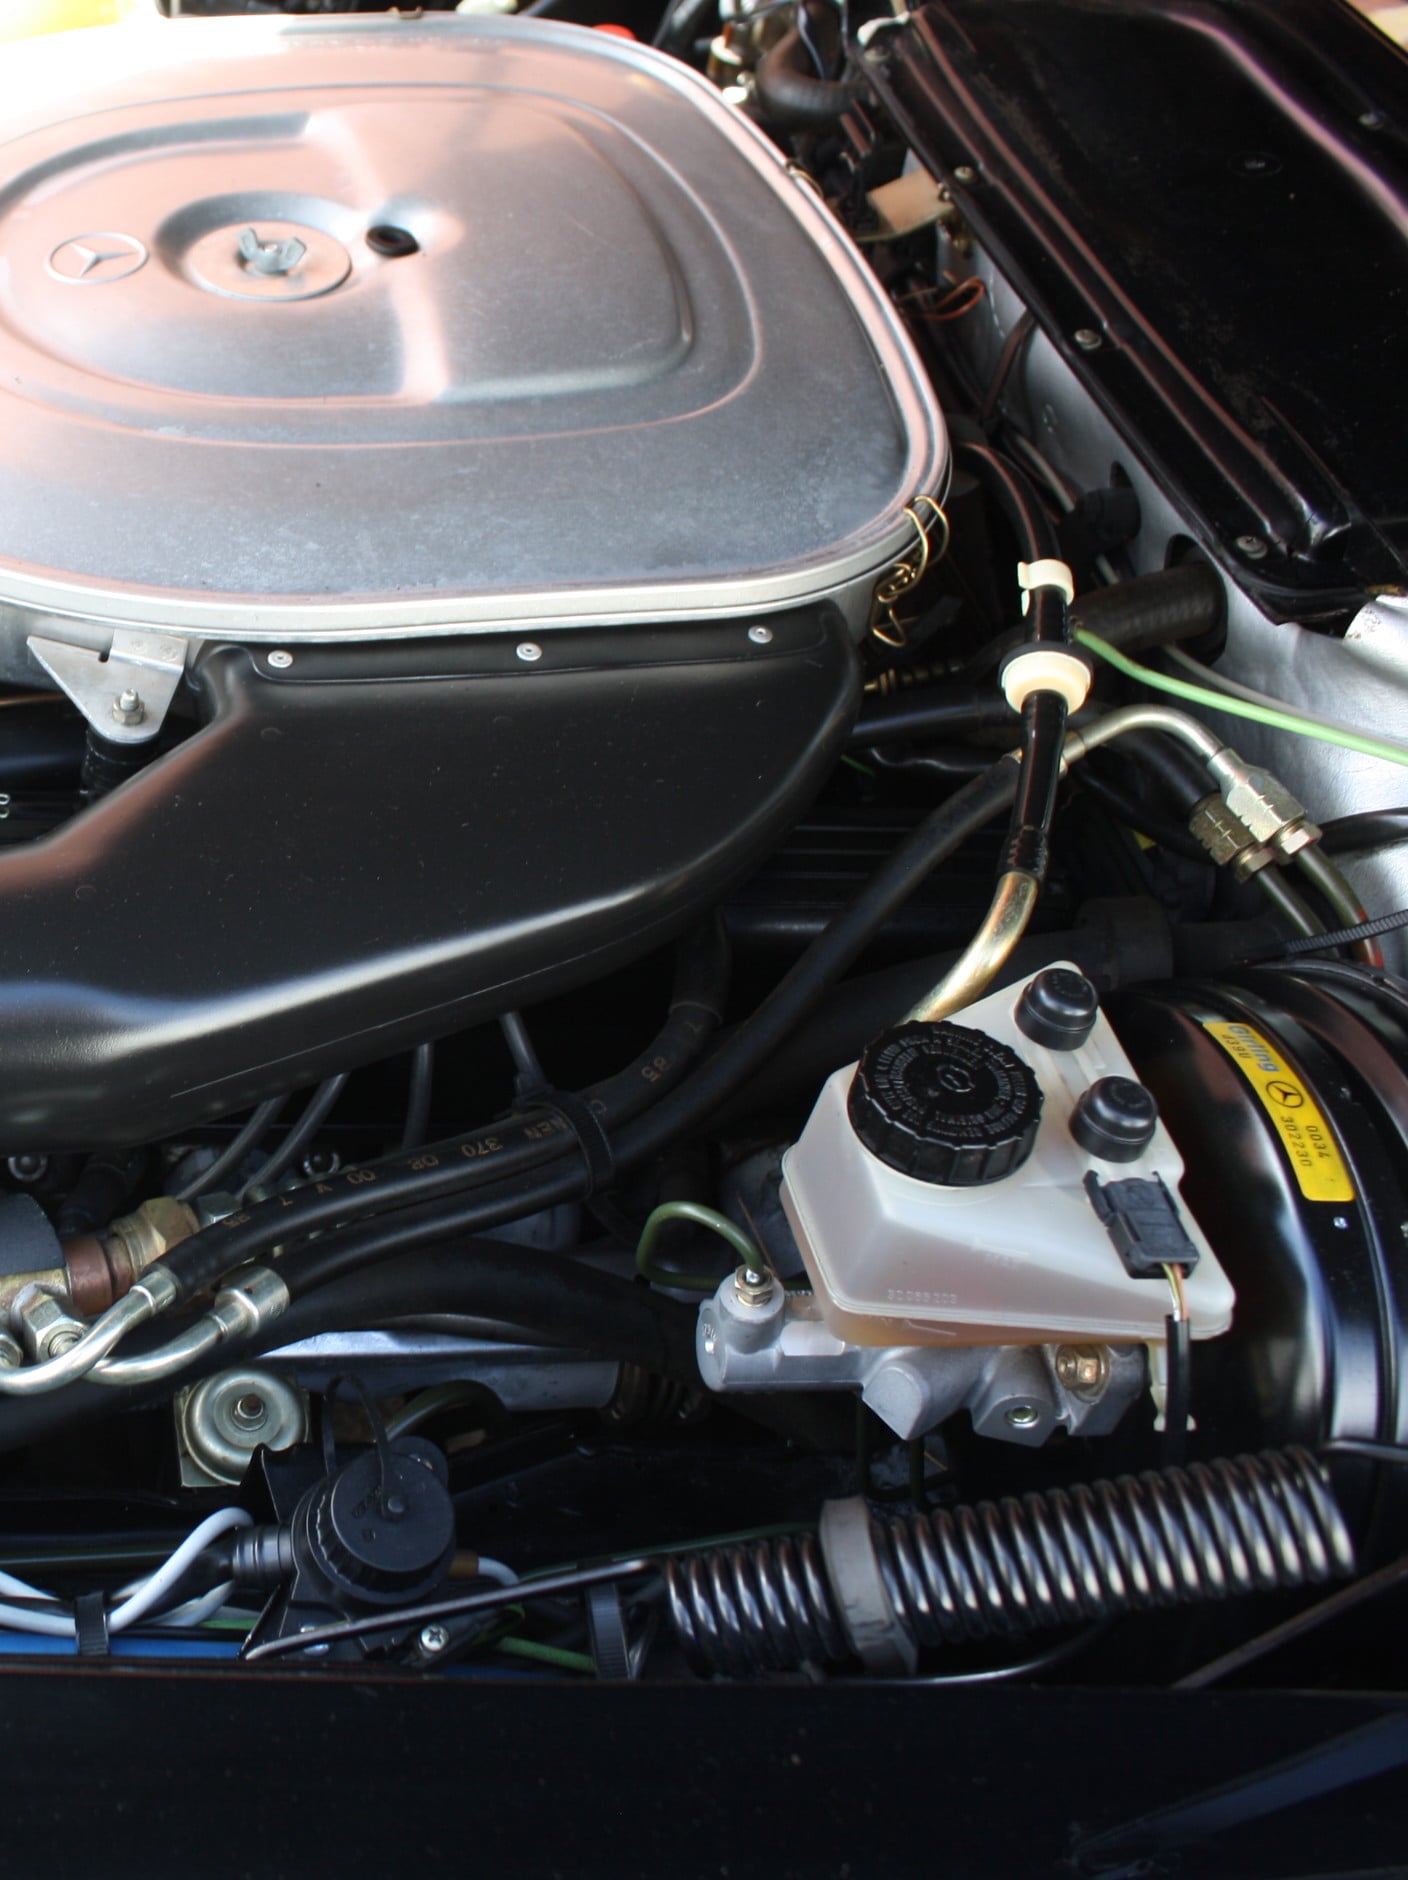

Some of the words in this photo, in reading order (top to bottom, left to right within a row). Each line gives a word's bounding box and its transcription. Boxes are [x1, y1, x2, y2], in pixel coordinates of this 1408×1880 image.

[1227, 1025, 1280, 1072] Girling
[460, 1137, 504, 1158] 370
[1280, 1116, 1313, 1167] 302230
[1305, 1125, 1331, 1158] 0034
